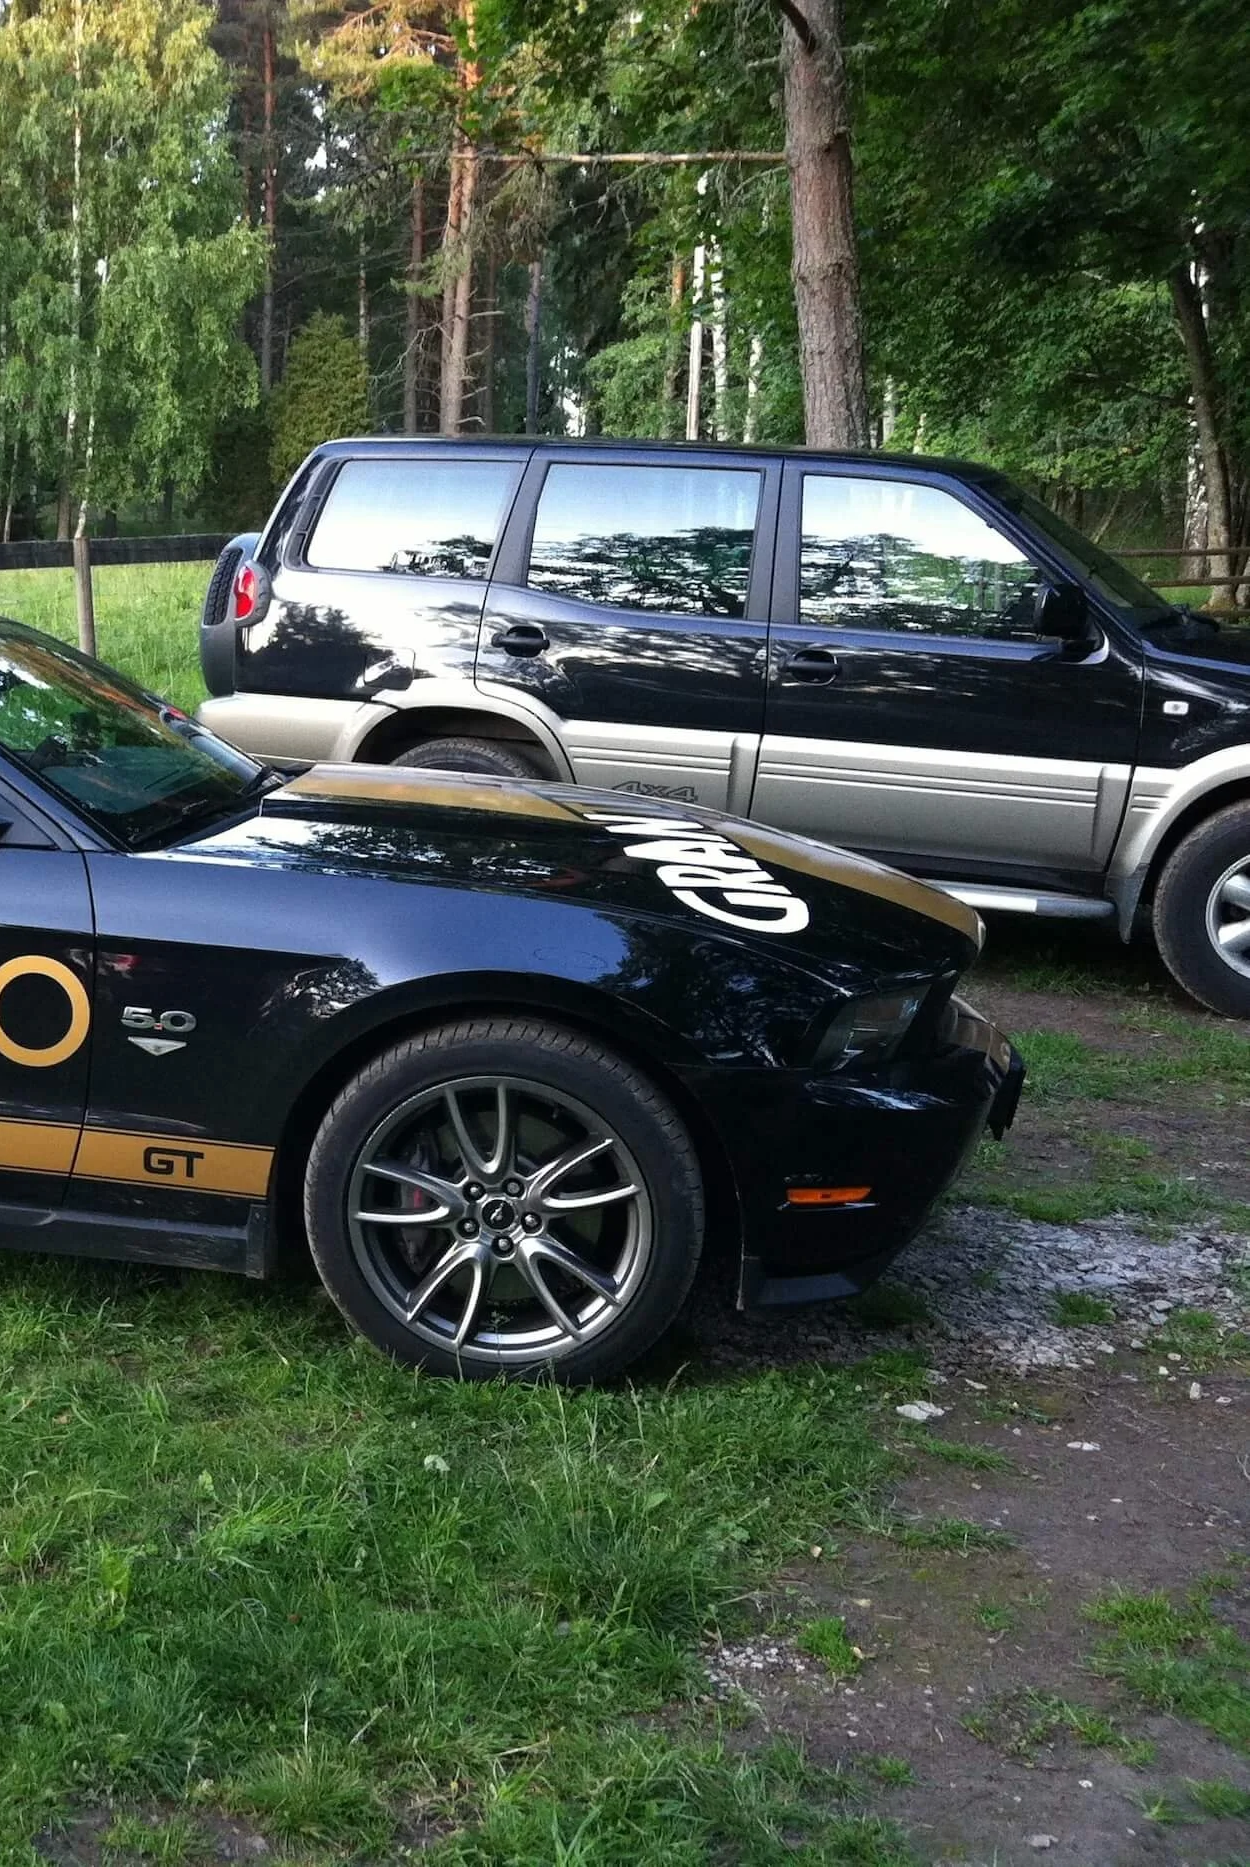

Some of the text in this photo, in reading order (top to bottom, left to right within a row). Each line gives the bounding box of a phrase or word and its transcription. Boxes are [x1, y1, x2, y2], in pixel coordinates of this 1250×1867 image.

[583, 813, 810, 934] GRAN
[120, 1006, 198, 1033] 5.0
[143, 1146, 205, 1178] GT
